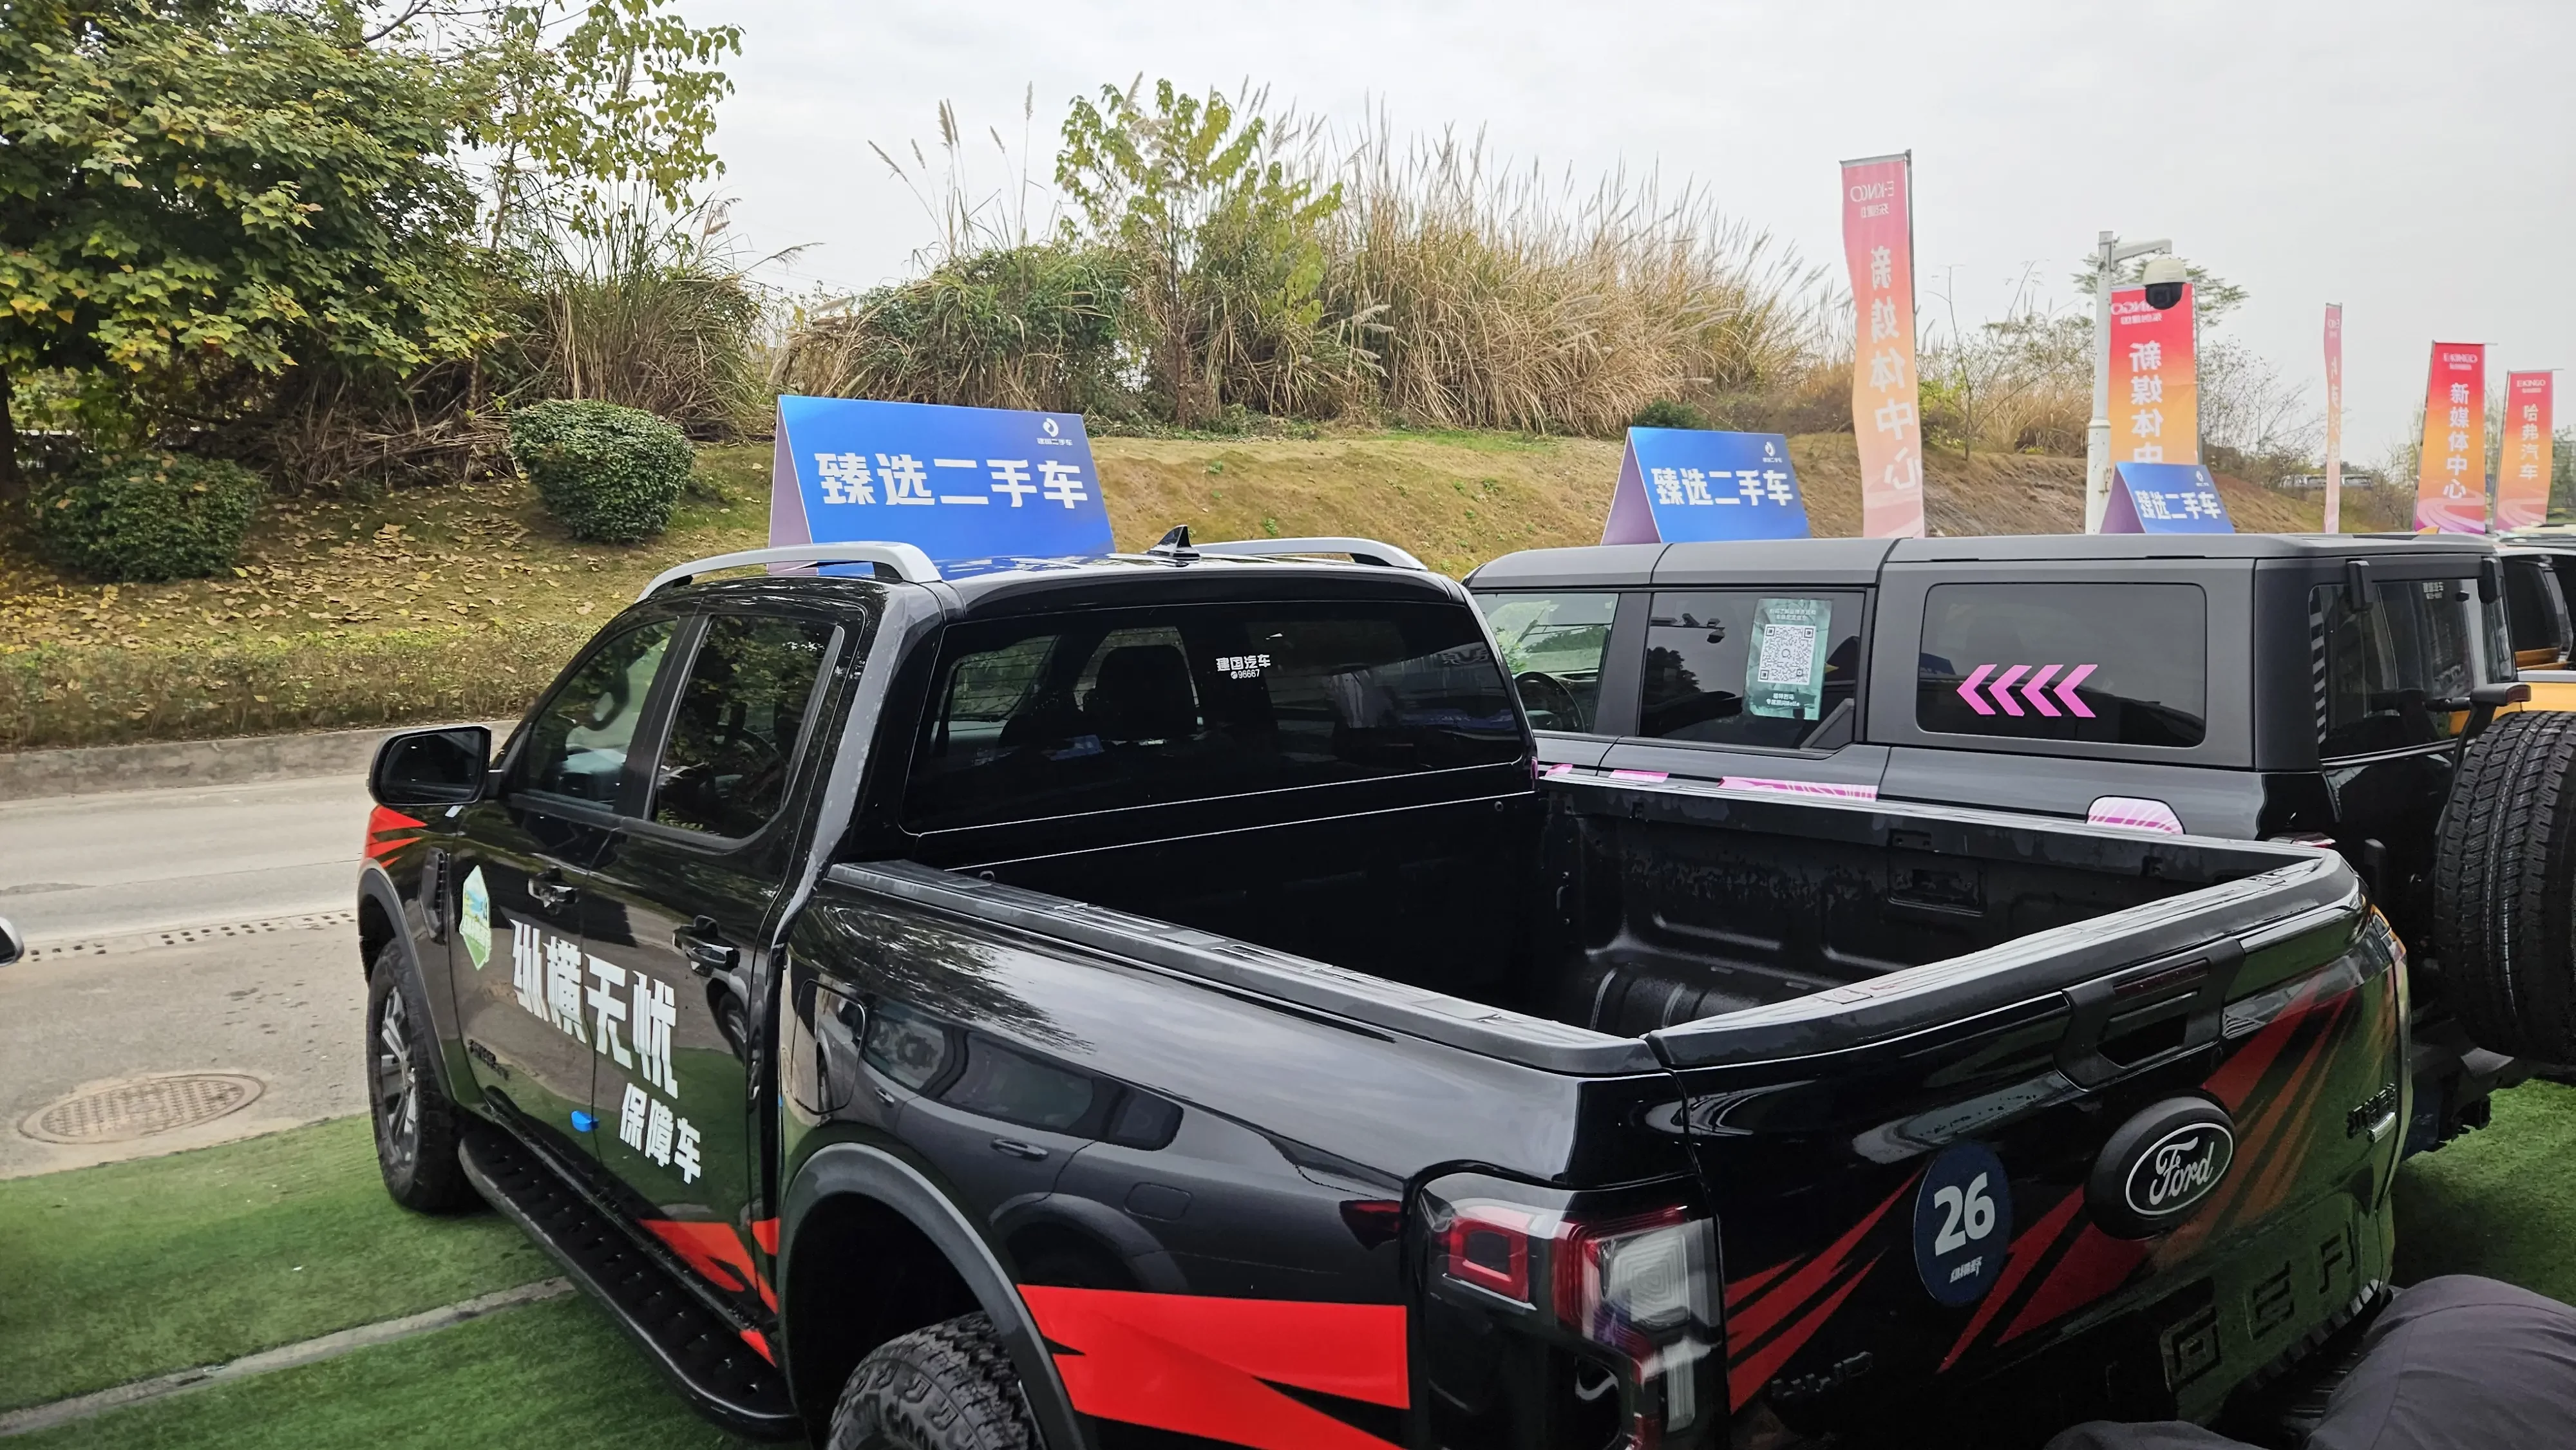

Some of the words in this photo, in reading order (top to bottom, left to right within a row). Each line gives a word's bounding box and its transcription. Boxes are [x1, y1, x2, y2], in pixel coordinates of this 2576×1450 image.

[2443, 382, 2470, 500] 新媒体中心
[2519, 403, 2539, 480] 哈弗汽车
[815, 453, 1088, 509] 臻选二手车
[1651, 467, 1794, 505] 臻选二手车
[1216, 654, 1271, 672] 建国汽车
[509, 918, 678, 1099] 纵横无忧
[620, 1083, 701, 1185] 保障车
[2149, 1137, 2215, 1205] Ford
[1934, 1172, 1995, 1256] 26
